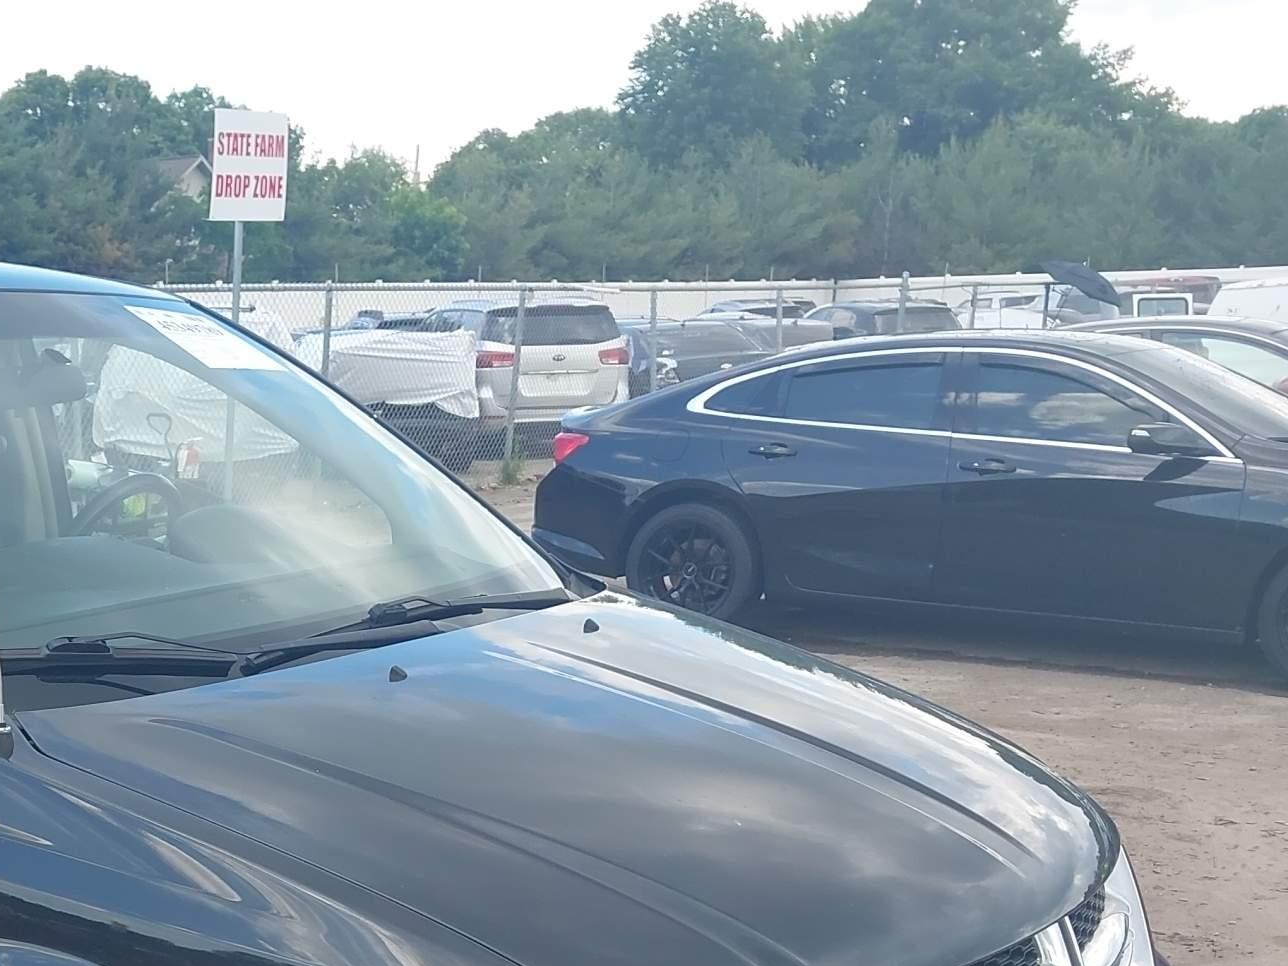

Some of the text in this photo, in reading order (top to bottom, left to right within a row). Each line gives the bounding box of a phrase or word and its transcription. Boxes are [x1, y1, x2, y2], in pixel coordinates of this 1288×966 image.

[217, 132, 285, 158] STATE FARM
[215, 174, 283, 199] DROP ZONE
